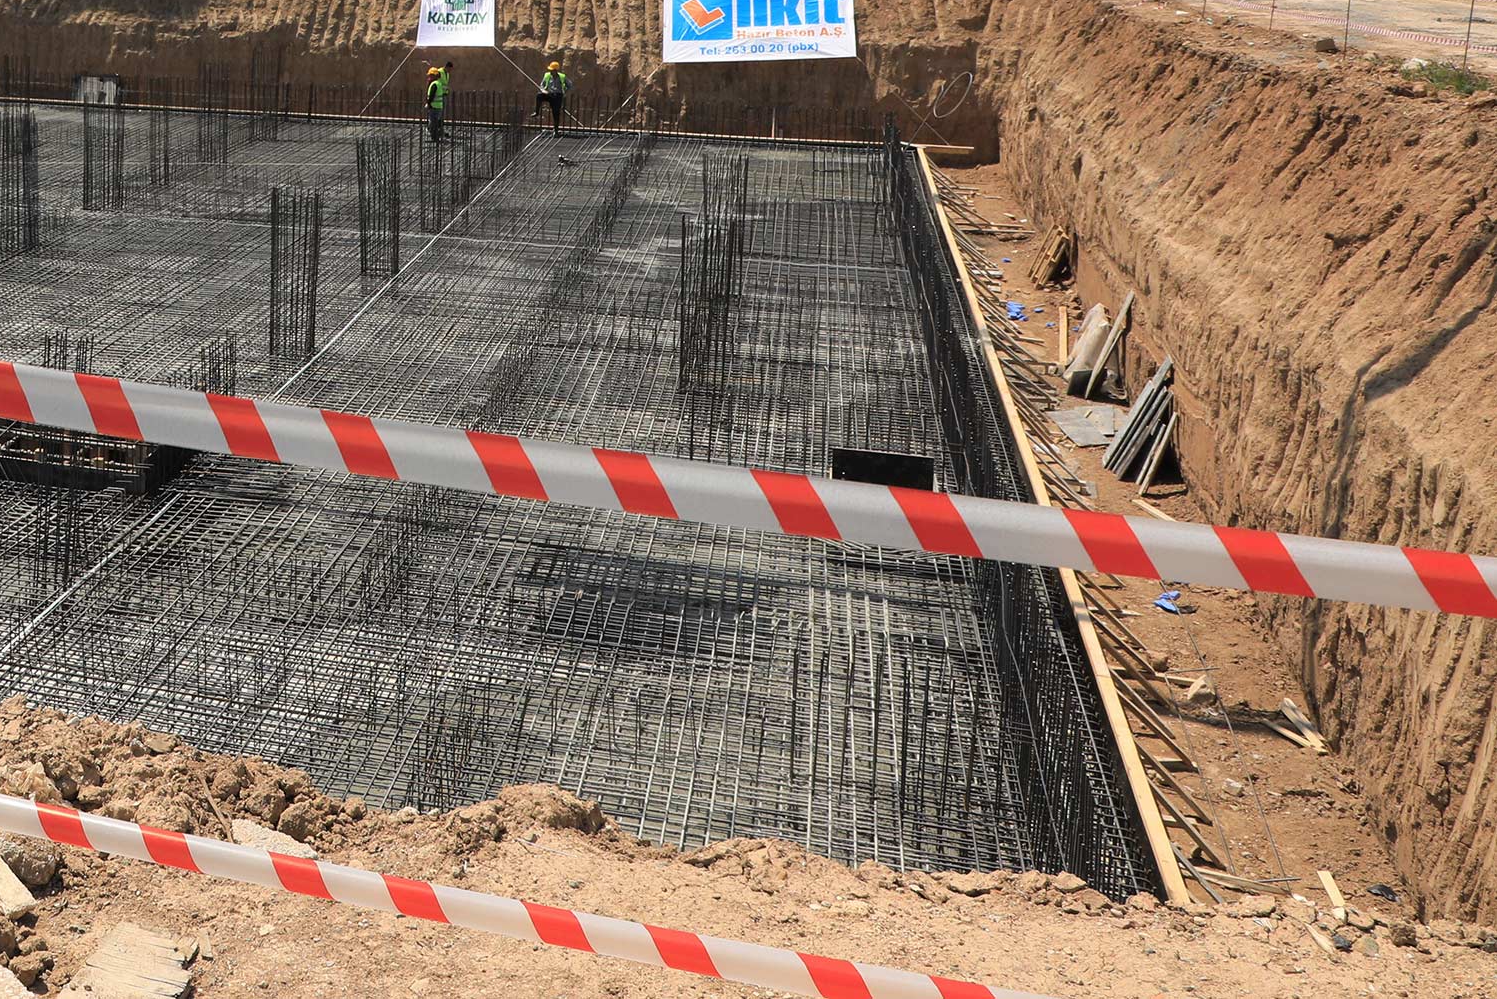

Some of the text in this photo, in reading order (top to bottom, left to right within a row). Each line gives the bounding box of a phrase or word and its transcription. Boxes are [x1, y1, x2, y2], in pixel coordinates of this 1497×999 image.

[427, 11, 488, 26] KARATAY
[775, 28, 815, 38] Beton
[820, 26, 847, 38] A.Ş.
[699, 46, 720, 56] Tel:
[750, 44, 765, 54] 00
[769, 43, 784, 53] 20
[787, 42, 819, 54] (pbx)
